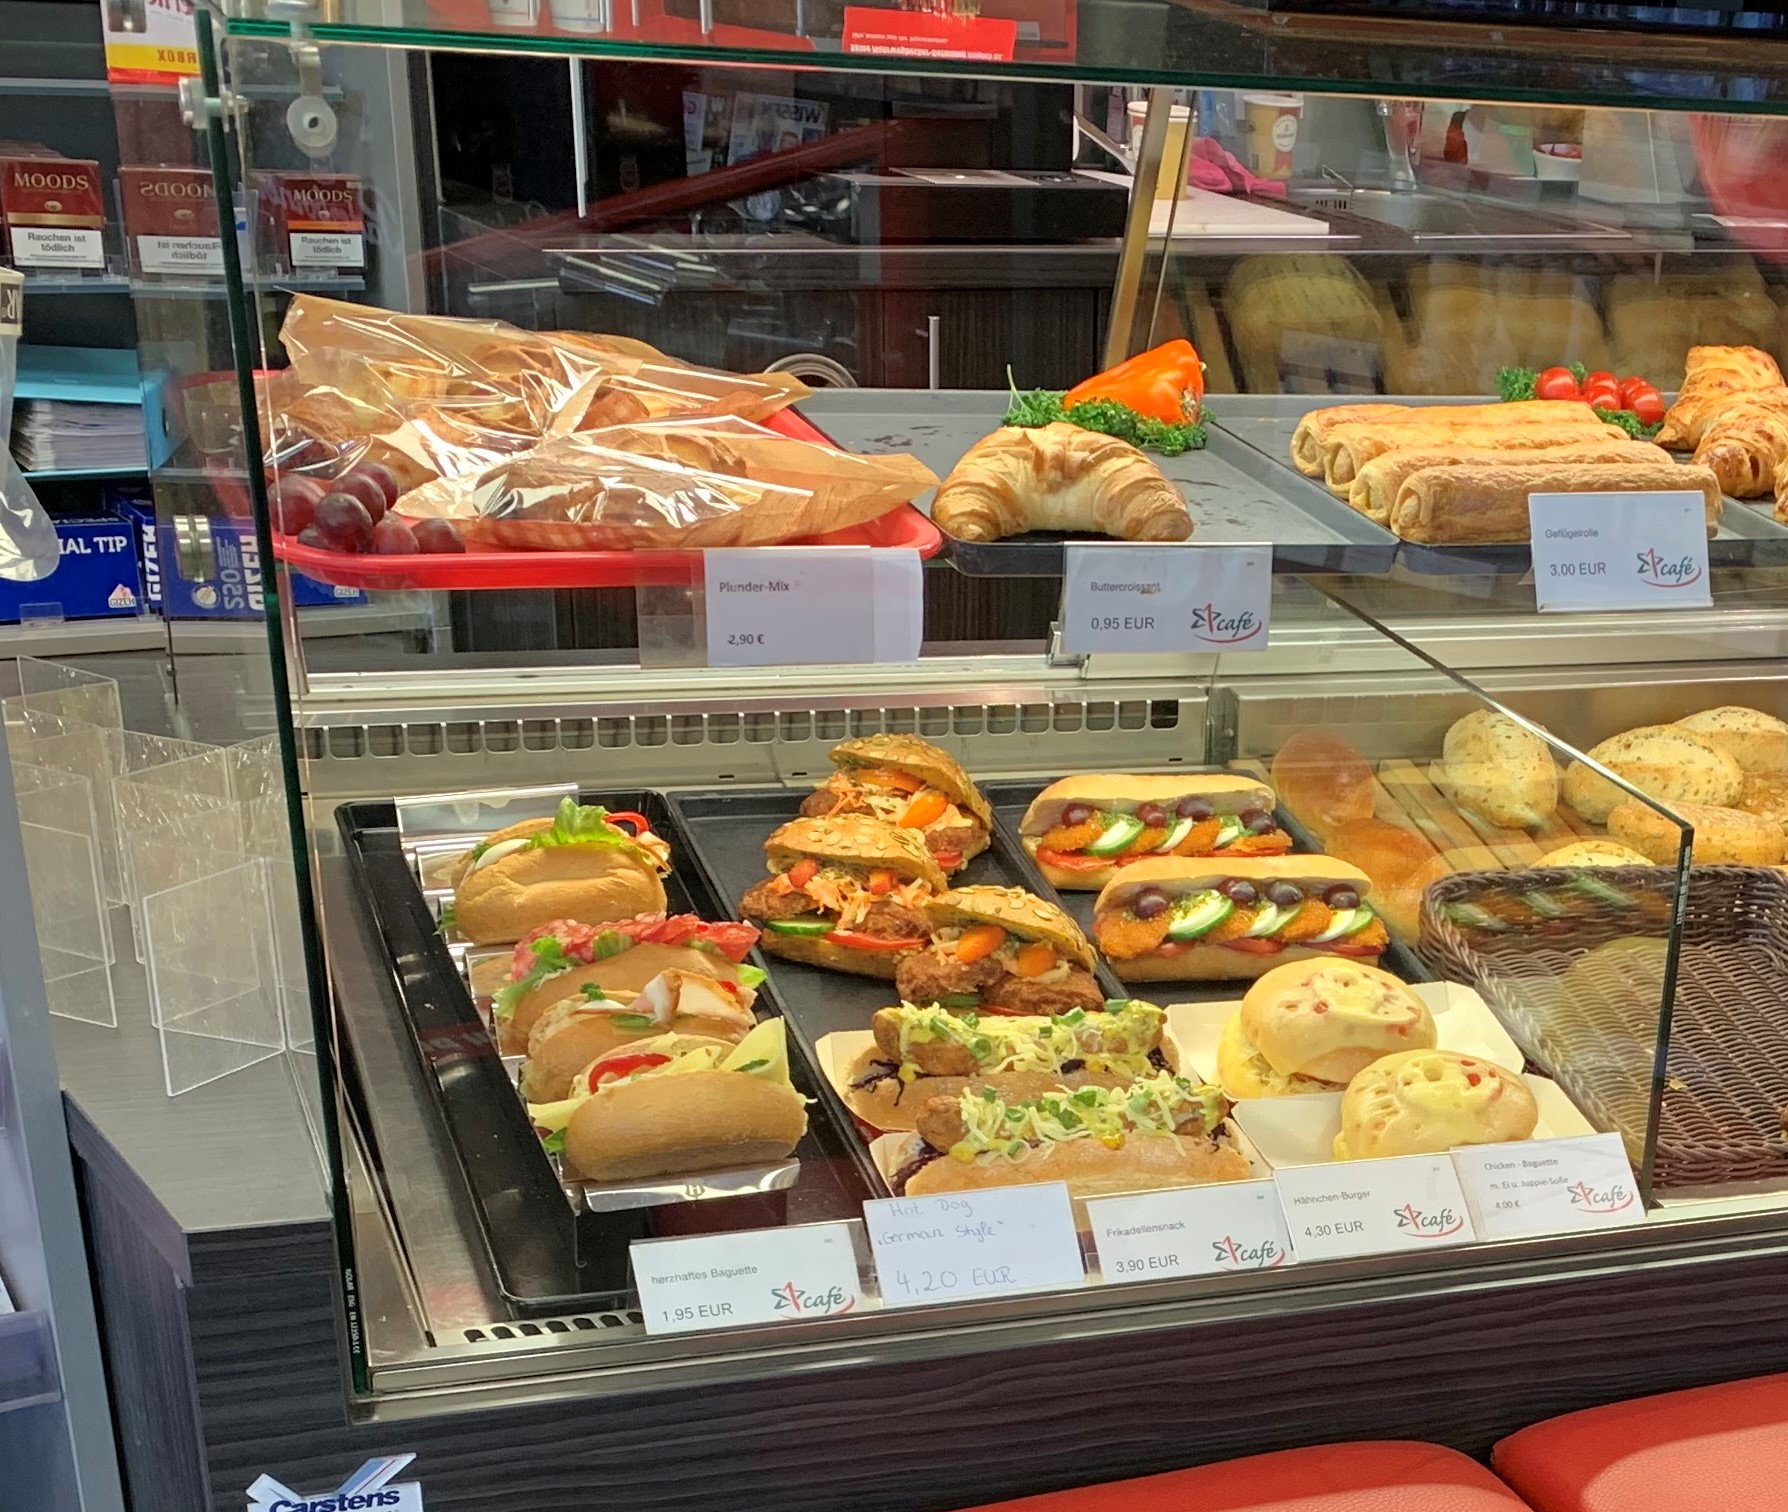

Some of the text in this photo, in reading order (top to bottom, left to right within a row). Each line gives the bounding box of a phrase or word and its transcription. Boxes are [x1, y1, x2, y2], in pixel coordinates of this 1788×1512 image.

[14, 172, 90, 191] MOODS
[293, 188, 353, 202] MOODS
[27, 232, 86, 243] Rauchen ist
[301, 236, 352, 245] Rauchen ist
[40, 242, 75, 253] tödlich
[313, 245, 342, 254] tödlich
[1545, 528, 1599, 540] Geflügelrolle
[93, 536, 127, 553] TIP
[1550, 562, 1607, 577] 3,00 EUR
[719, 581, 790, 593] Plunder-Mix
[1090, 581, 1162, 594] Buttercroissant
[110, 597, 136, 607] GIZEH
[1091, 616, 1155, 630] 0,95 EUR
[727, 633, 765, 646] 2,90 €
[1484, 1161, 1516, 1171] Chicken
[1522, 1158, 1559, 1170] Baguette
[1293, 1190, 1371, 1206] Hähnchen-Burger
[1514, 1199, 1521, 1208] €
[890, 1198, 973, 1218] Hot Dog
[1106, 1220, 1186, 1238] Frikadellensnack
[1304, 1220, 1365, 1239] 4,30 EUR
[1115, 1254, 1180, 1274] 3,90 EUR
[651, 1265, 759, 1285] herzhaftes Baguette
[896, 1266, 1017, 1295] 4,20 EUR
[662, 1302, 734, 1324] 1,95 EUR
